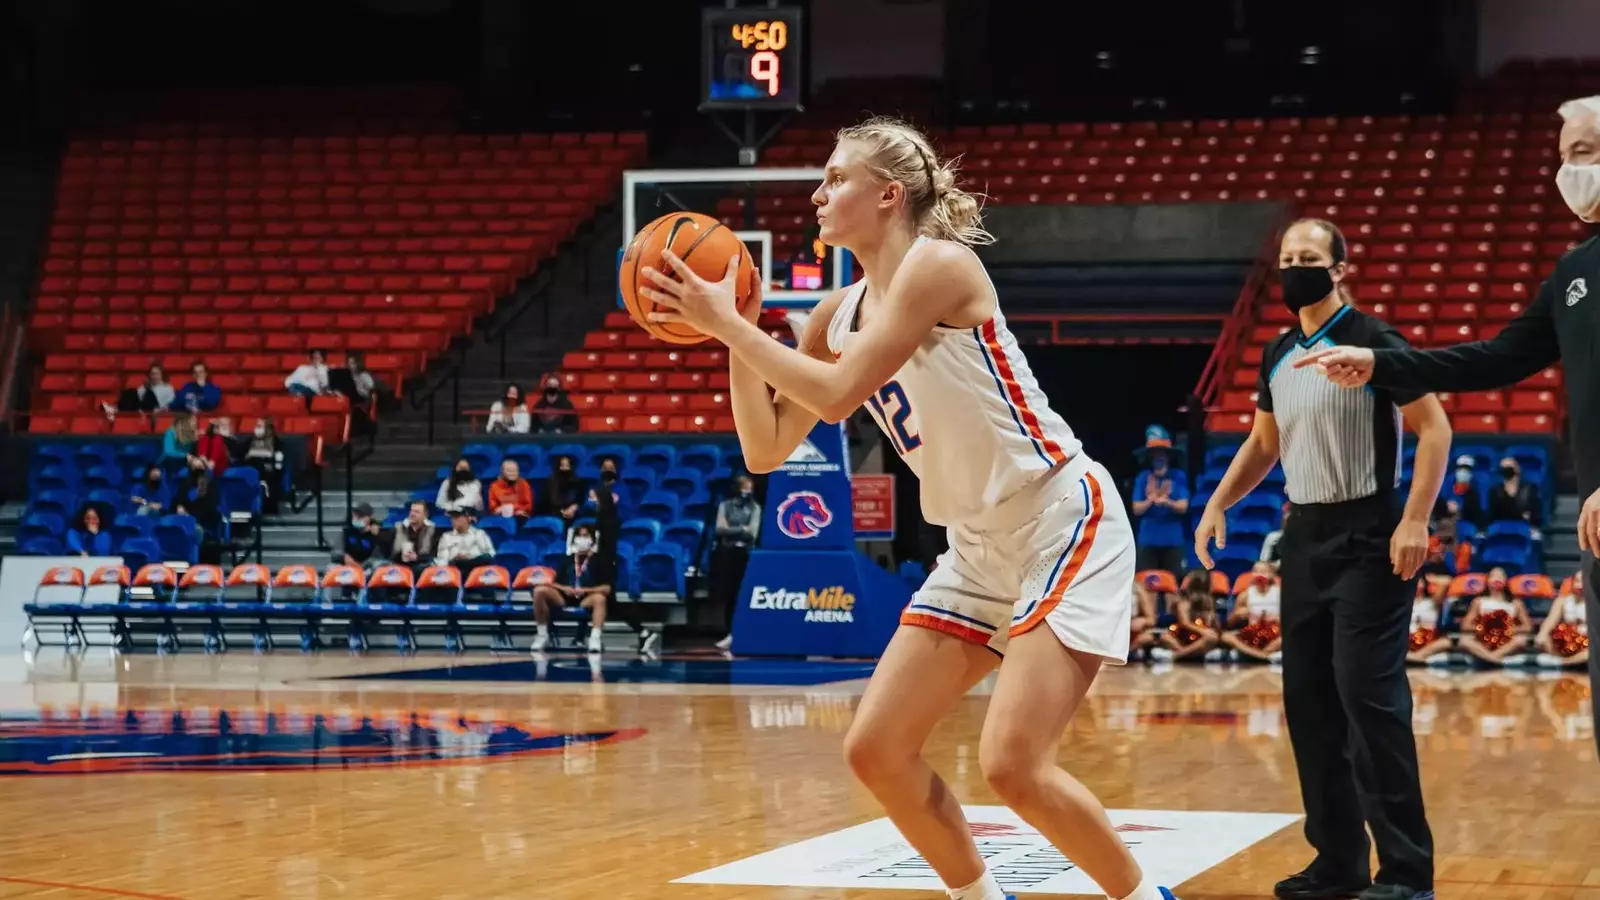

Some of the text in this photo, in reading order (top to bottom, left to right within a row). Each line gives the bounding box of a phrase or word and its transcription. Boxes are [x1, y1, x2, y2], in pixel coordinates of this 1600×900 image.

[732, 21, 787, 51] 4:50
[751, 51, 779, 96] 9
[749, 585, 856, 612] ExtraMile
[804, 610, 854, 623] ARENA
